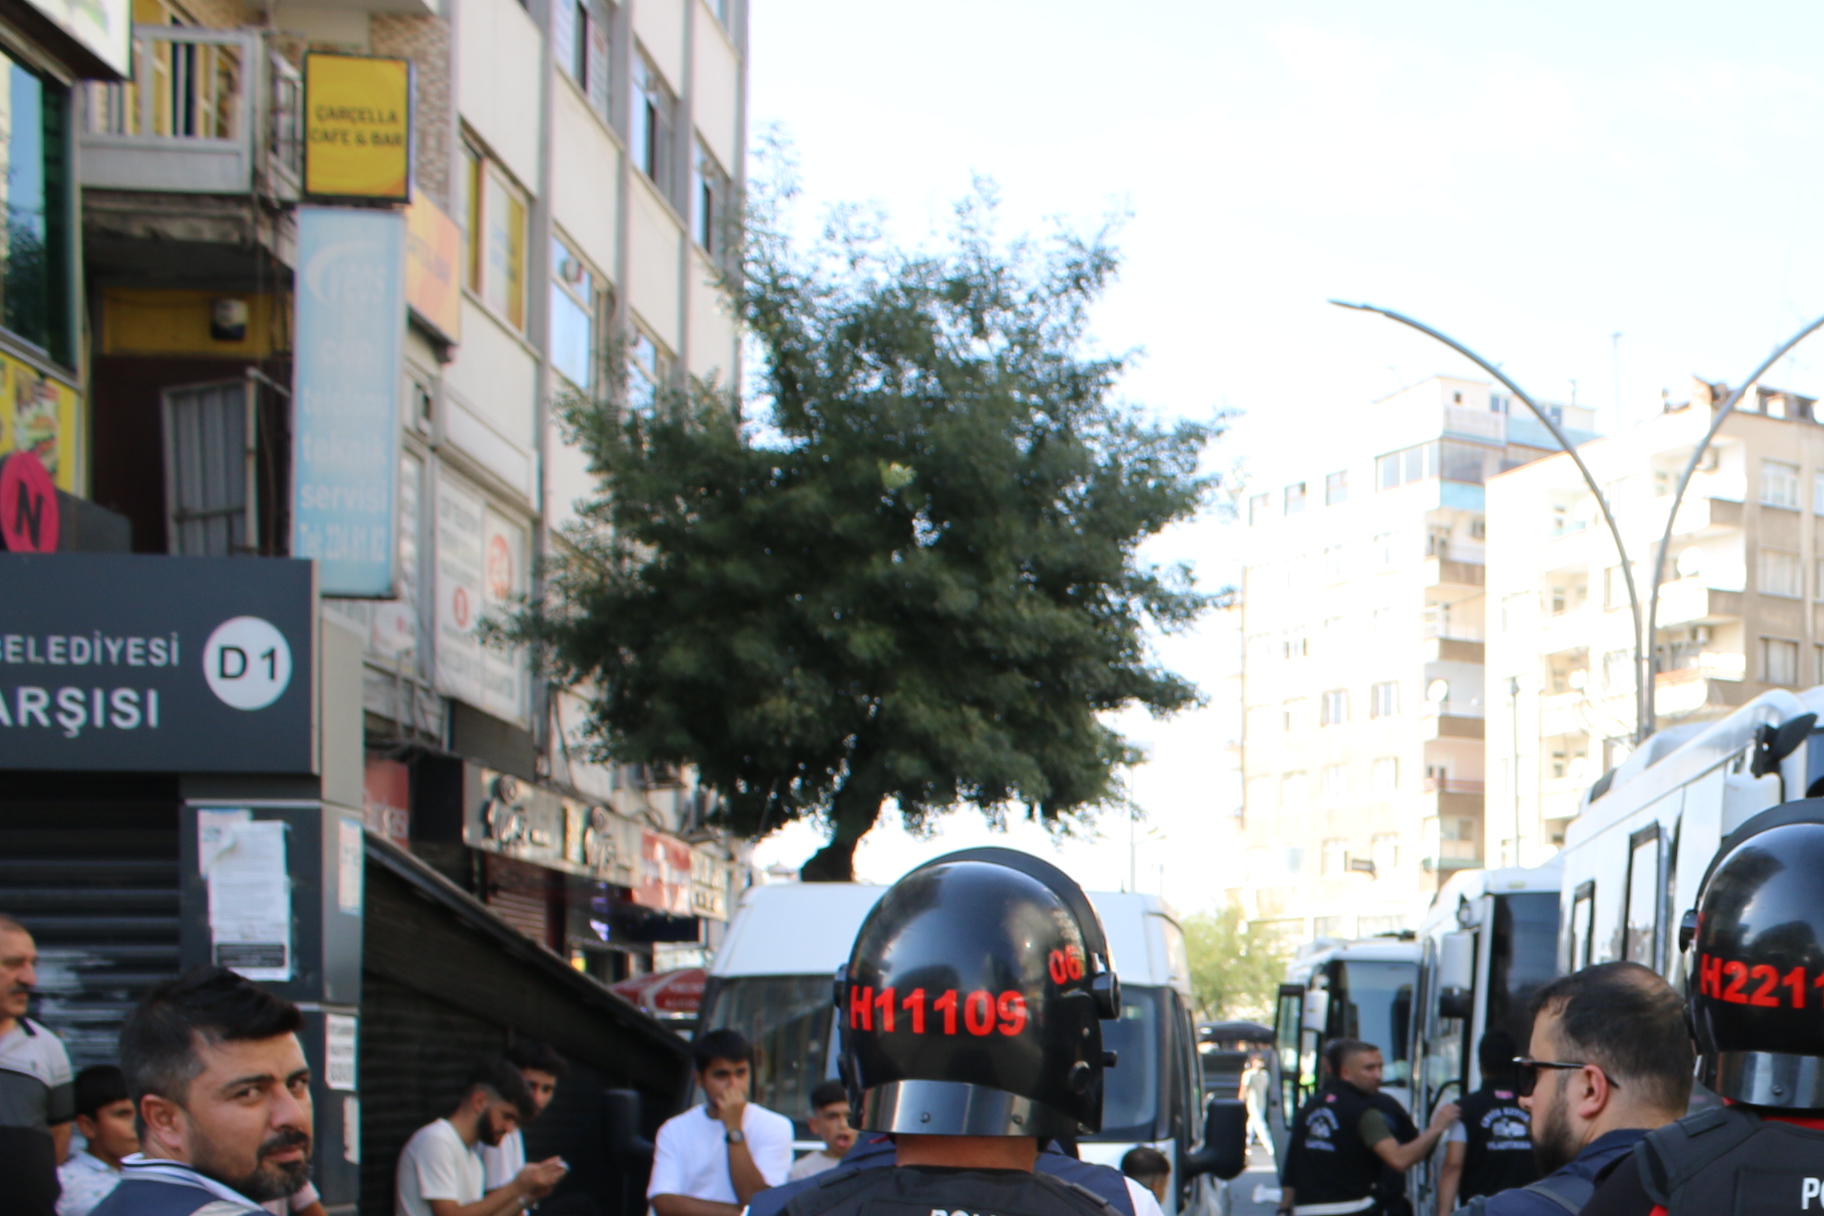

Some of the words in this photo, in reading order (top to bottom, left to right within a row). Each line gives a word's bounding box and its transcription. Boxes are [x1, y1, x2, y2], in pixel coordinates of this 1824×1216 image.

[309, 128, 350, 145] CAFE
[371, 131, 402, 147] BAR
[301, 479, 387, 512] servisi
[0, 631, 179, 667] ELEDİYESİ
[1049, 945, 1082, 984] 06
[850, 985, 1027, 1036] H11109
